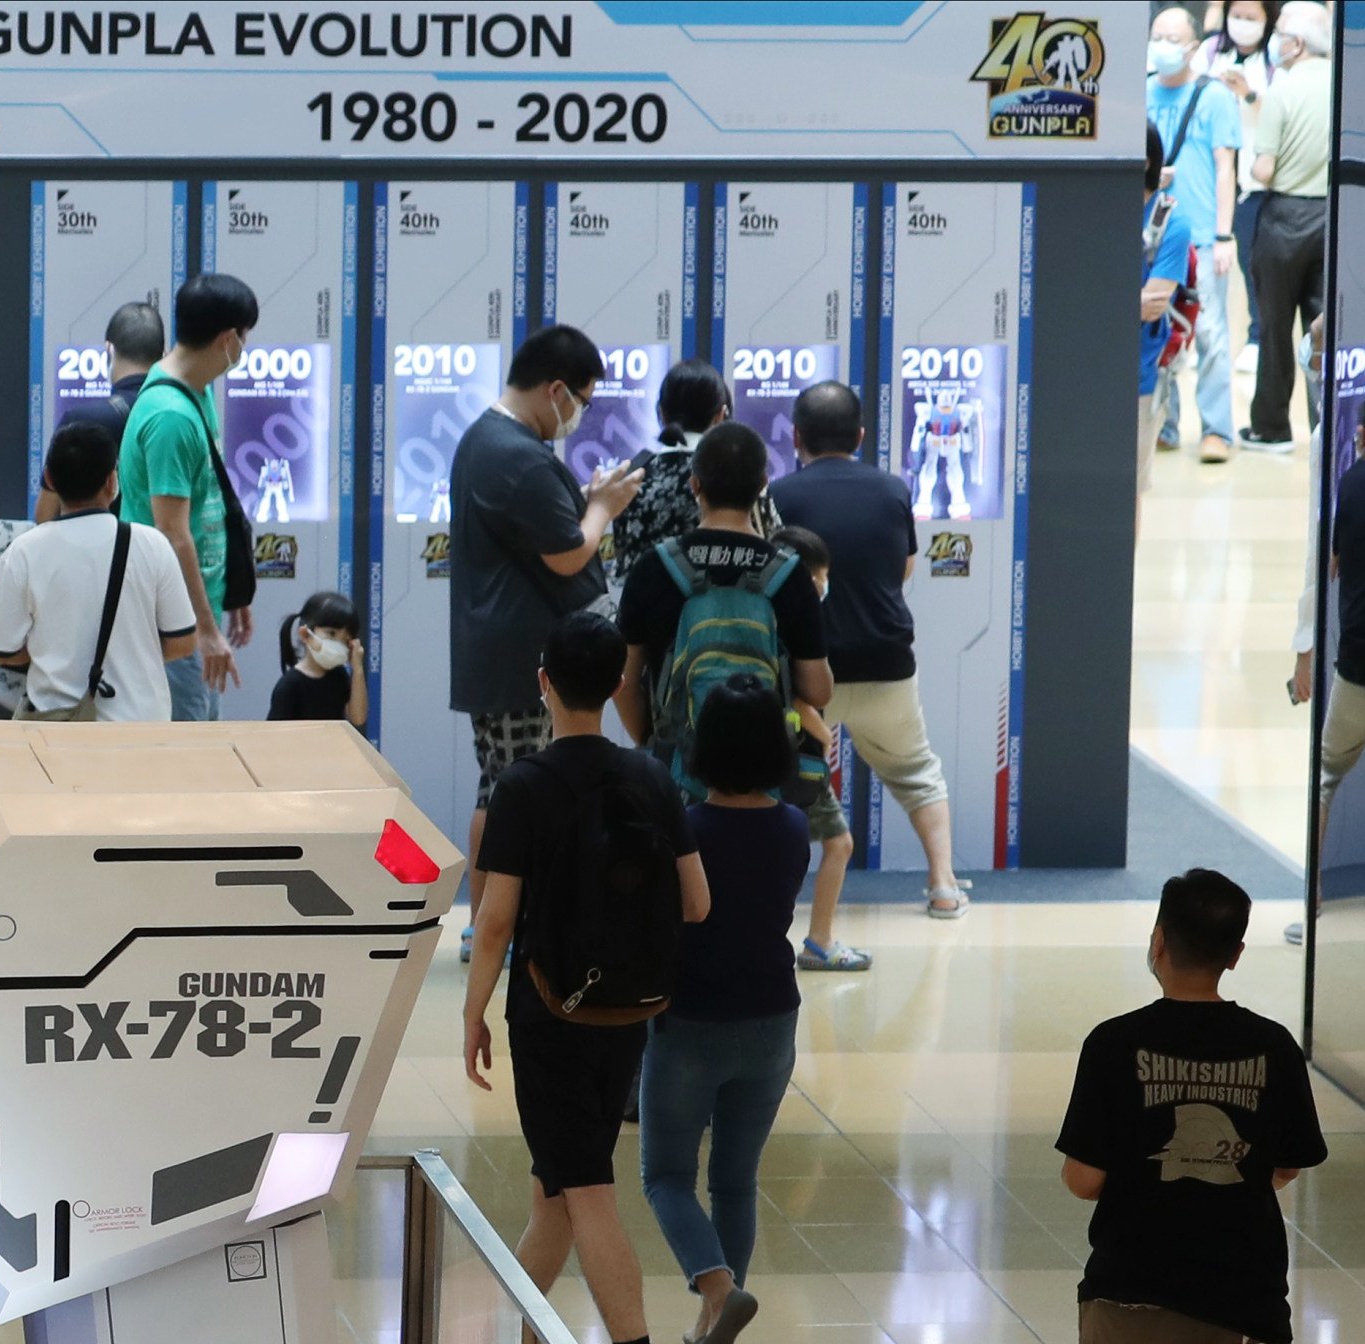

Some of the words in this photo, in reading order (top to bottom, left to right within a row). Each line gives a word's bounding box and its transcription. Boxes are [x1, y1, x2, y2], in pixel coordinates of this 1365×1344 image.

[236, 12, 572, 58] EVOLUTION
[308, 92, 457, 142] 1980
[515, 93, 668, 143] 2020
[992, 116, 1090, 135] GUNPLA
[1003, 104, 1083, 114] ANNIVERSARY
[32, 205, 43, 270] EXHIBITION
[57, 212, 97, 228] 30th
[229, 212, 269, 227] 30th
[344, 205, 356, 271] EXHIBITION
[375, 206, 387, 272] EXHIBITION
[400, 213, 440, 229] 40th
[515, 206, 527, 272] EXHIBITION
[544, 207, 556, 273] EXHIBITION
[570, 214, 609, 230] 40th
[684, 207, 697, 273] EXHIBITION
[714, 207, 726, 273] EXHIBITION
[739, 214, 779, 230] 40th
[853, 207, 866, 273] EXHIBITION
[882, 207, 895, 273] EXHIBITION
[908, 214, 947, 229] 40th
[1021, 207, 1033, 273] EXHIBITION
[31, 275, 43, 315] HOBBY
[344, 275, 355, 315] HOBBY
[375, 275, 386, 316] HOBBY
[515, 275, 527, 316] HOBBY
[544, 276, 555, 316] HOBBY
[684, 276, 696, 316] HOBBY
[713, 276, 725, 317] HOBBY
[852, 276, 864, 317] HOBBY
[881, 276, 893, 317] HOBBY
[1020, 276, 1032, 316] HOBBY
[227, 348, 312, 380] 2000
[394, 345, 477, 376] 2010
[733, 348, 816, 381] 2010
[901, 348, 984, 380] 2010
[342, 385, 354, 451] EXHIBITION
[373, 385, 384, 450] EXHIBITION
[878, 385, 891, 451] EXHIBITION
[1017, 385, 1030, 450] EXHIBITION
[342, 454, 353, 495] HOBBY
[372, 454, 383, 495] HOBBY
[1017, 454, 1028, 494] HOBBY
[370, 562, 382, 629] EXHIBITION
[1014, 561, 1027, 628] EXHIBITION
[369, 632, 381, 672] HOBBY
[1013, 629, 1025, 670] HOBBY
[1011, 737, 1023, 804] EXHIBITION
[1010, 806, 1022, 845] HOBBY
[178, 972, 326, 998] GUNDAM
[24, 999, 322, 1064] RX-78-2
[1136, 1047, 1266, 1088] SHIKISHIMA
[1144, 1083, 1185, 1109] HEAVY
[1187, 1084, 1259, 1113] INDUSTRIES
[1216, 1139, 1246, 1162] 28
[90, 1208, 120, 1216] ARMOR
[121, 1206, 143, 1214] LOCK
